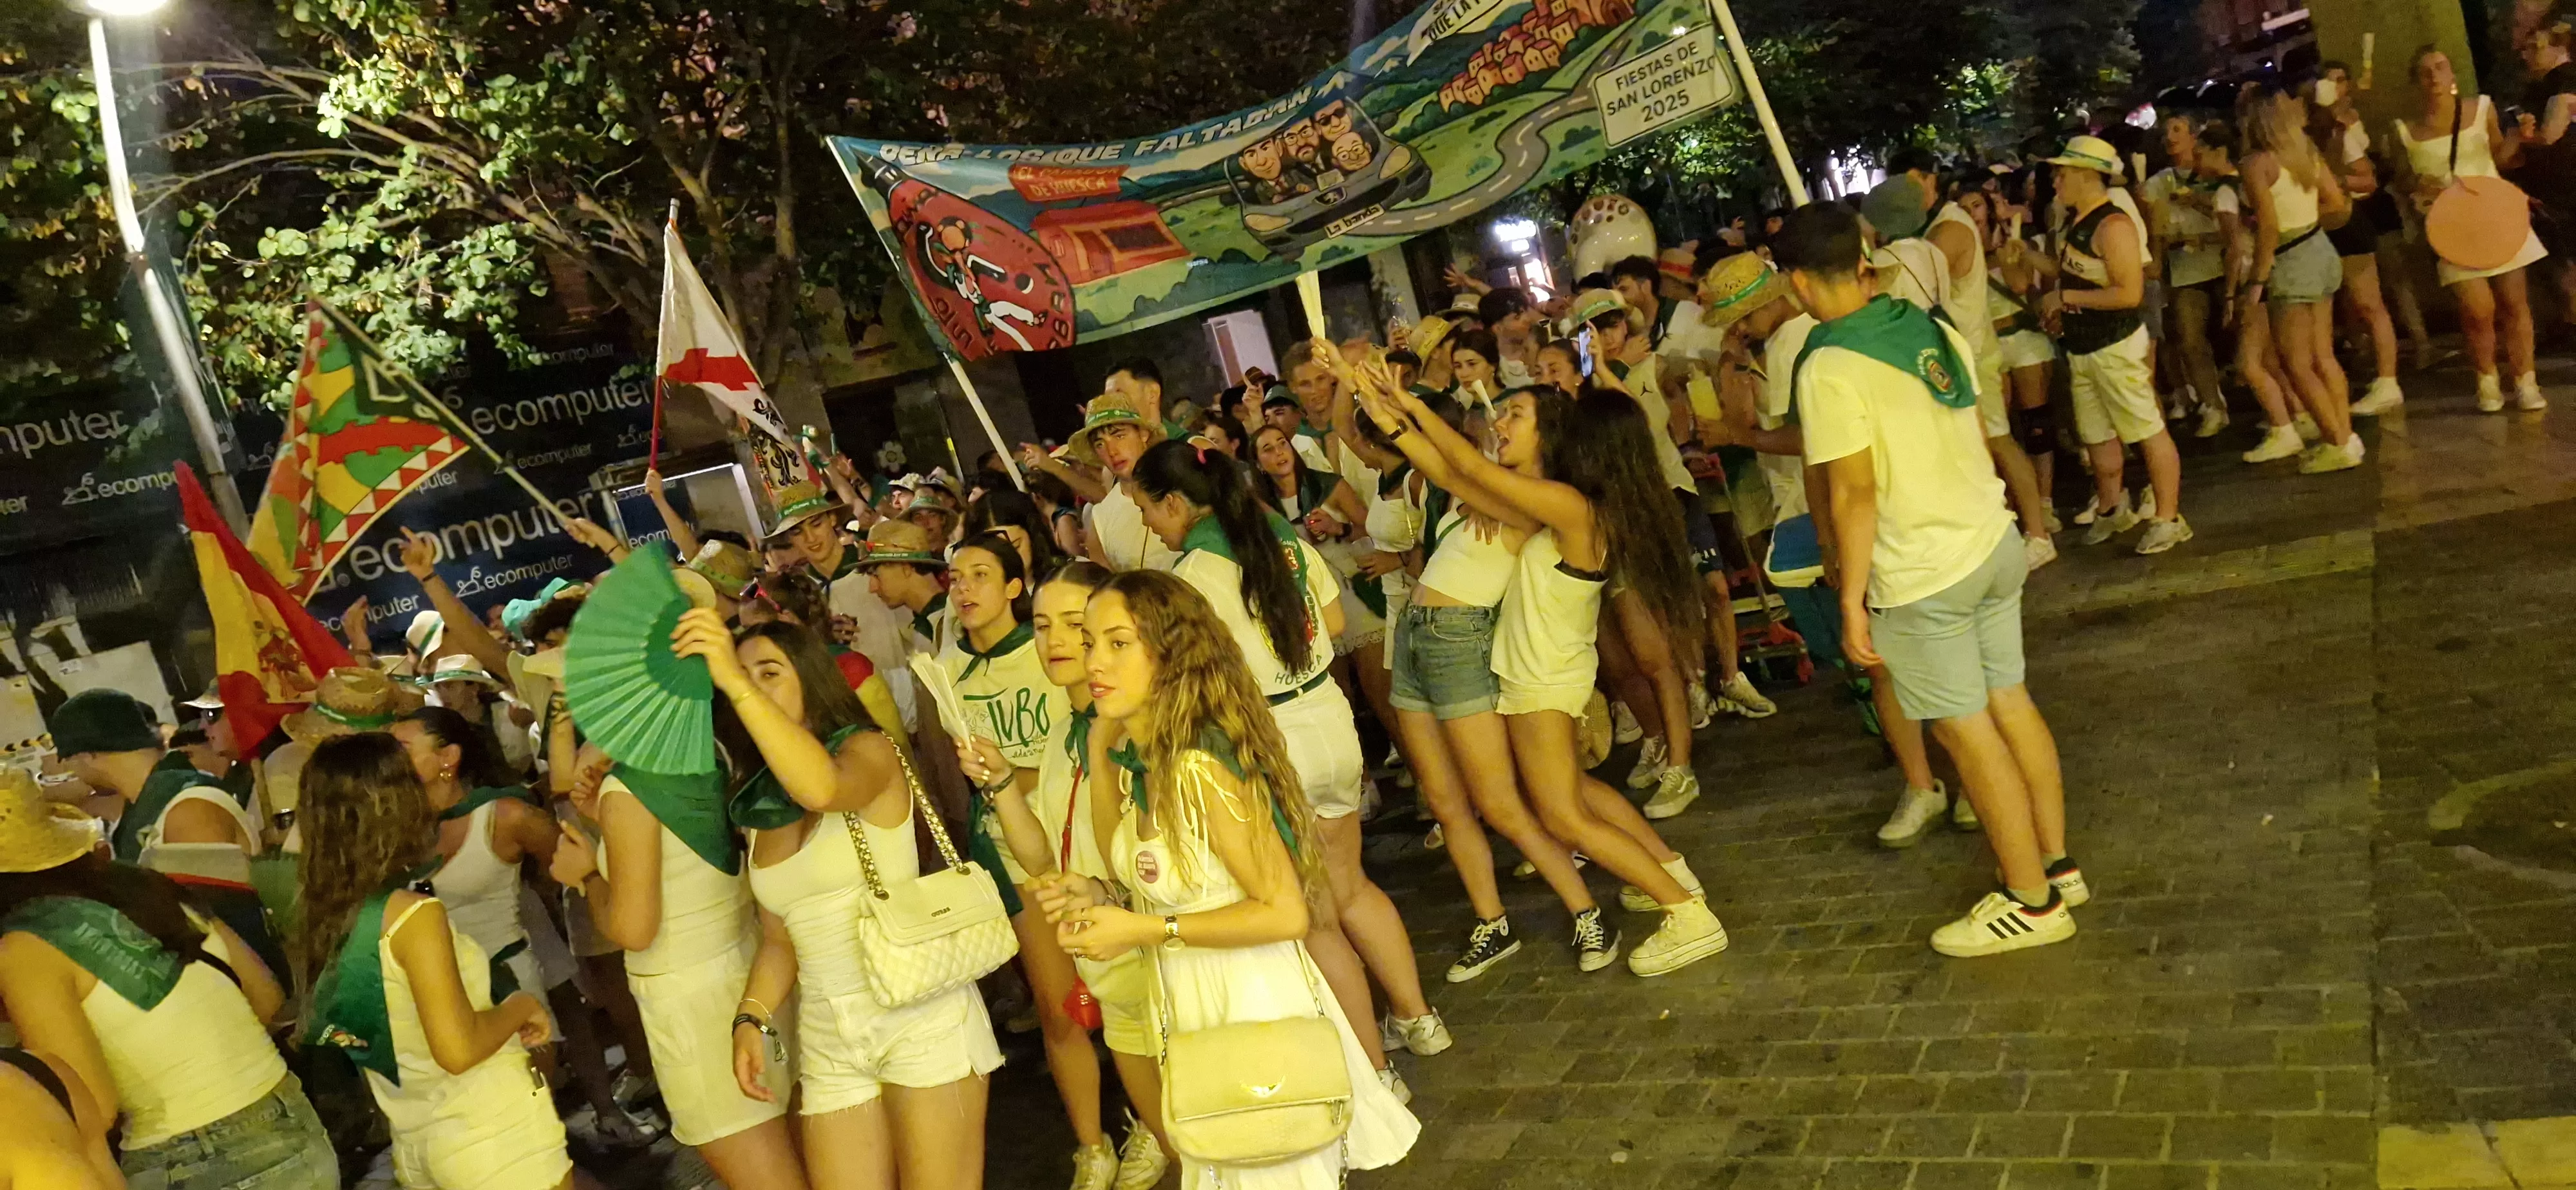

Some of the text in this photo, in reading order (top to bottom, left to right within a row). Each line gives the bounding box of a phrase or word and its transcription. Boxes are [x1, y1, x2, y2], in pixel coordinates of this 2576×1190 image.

[1615, 41, 1699, 91] FIESTAS DE
[1606, 90, 1638, 116] SAN
[1641, 88, 1690, 123] 2025
[1053, 143, 1126, 165] QUE
[1342, 205, 1380, 227] banda
[471, 375, 652, 436] ecomputer
[1274, 654, 1322, 685] HUESCA
